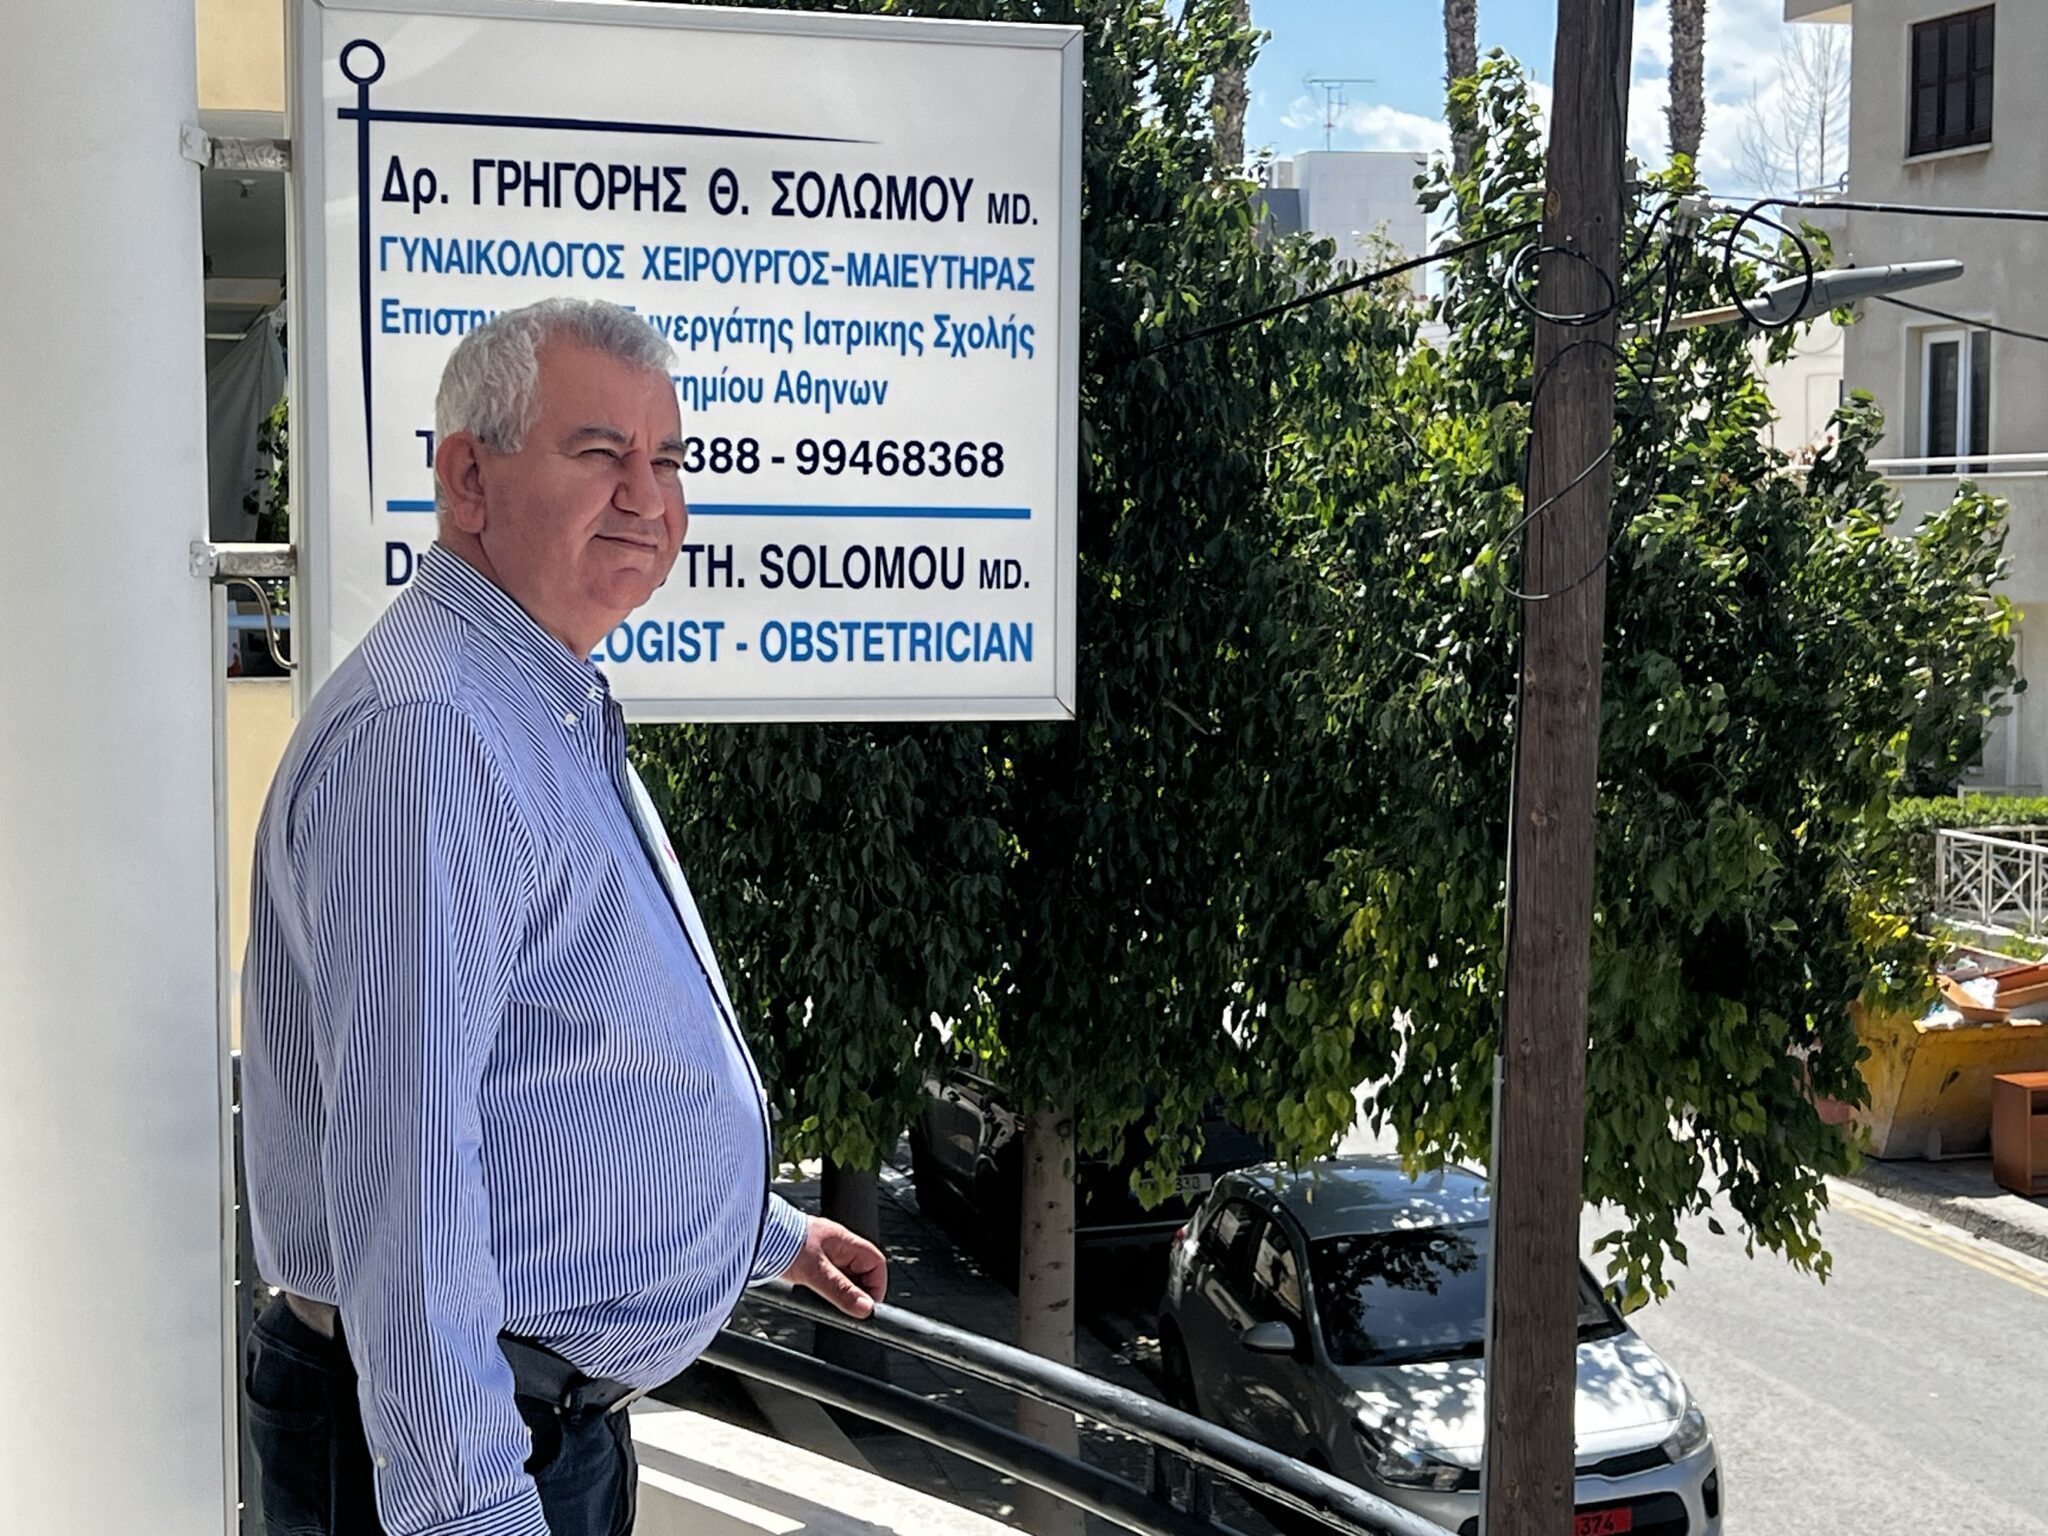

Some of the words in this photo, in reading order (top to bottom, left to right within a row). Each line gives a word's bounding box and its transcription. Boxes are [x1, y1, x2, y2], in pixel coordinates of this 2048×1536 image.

[381, 155, 449, 214] Δρ.
[472, 158, 687, 213] ΓΡΗΓΟΡΗΣ
[708, 167, 749, 216] Θ.
[771, 170, 974, 223] ΣΟΛΩΜΟΥ
[987, 192, 1038, 225] MD.
[379, 235, 625, 280] ΓΥΝΑΙΚΟΛΟΓΟΣ
[804, 310, 925, 357] Ιατρικης
[932, 313, 1035, 360] Σχολής
[773, 369, 889, 414] Αθηνων
[795, 438, 1006, 478] 99468368
[681, 543, 746, 589] TH.
[759, 544, 966, 590] SOLOMOU
[978, 558, 1031, 590] MD.
[759, 620, 1035, 663] OBSTETRICIAN
